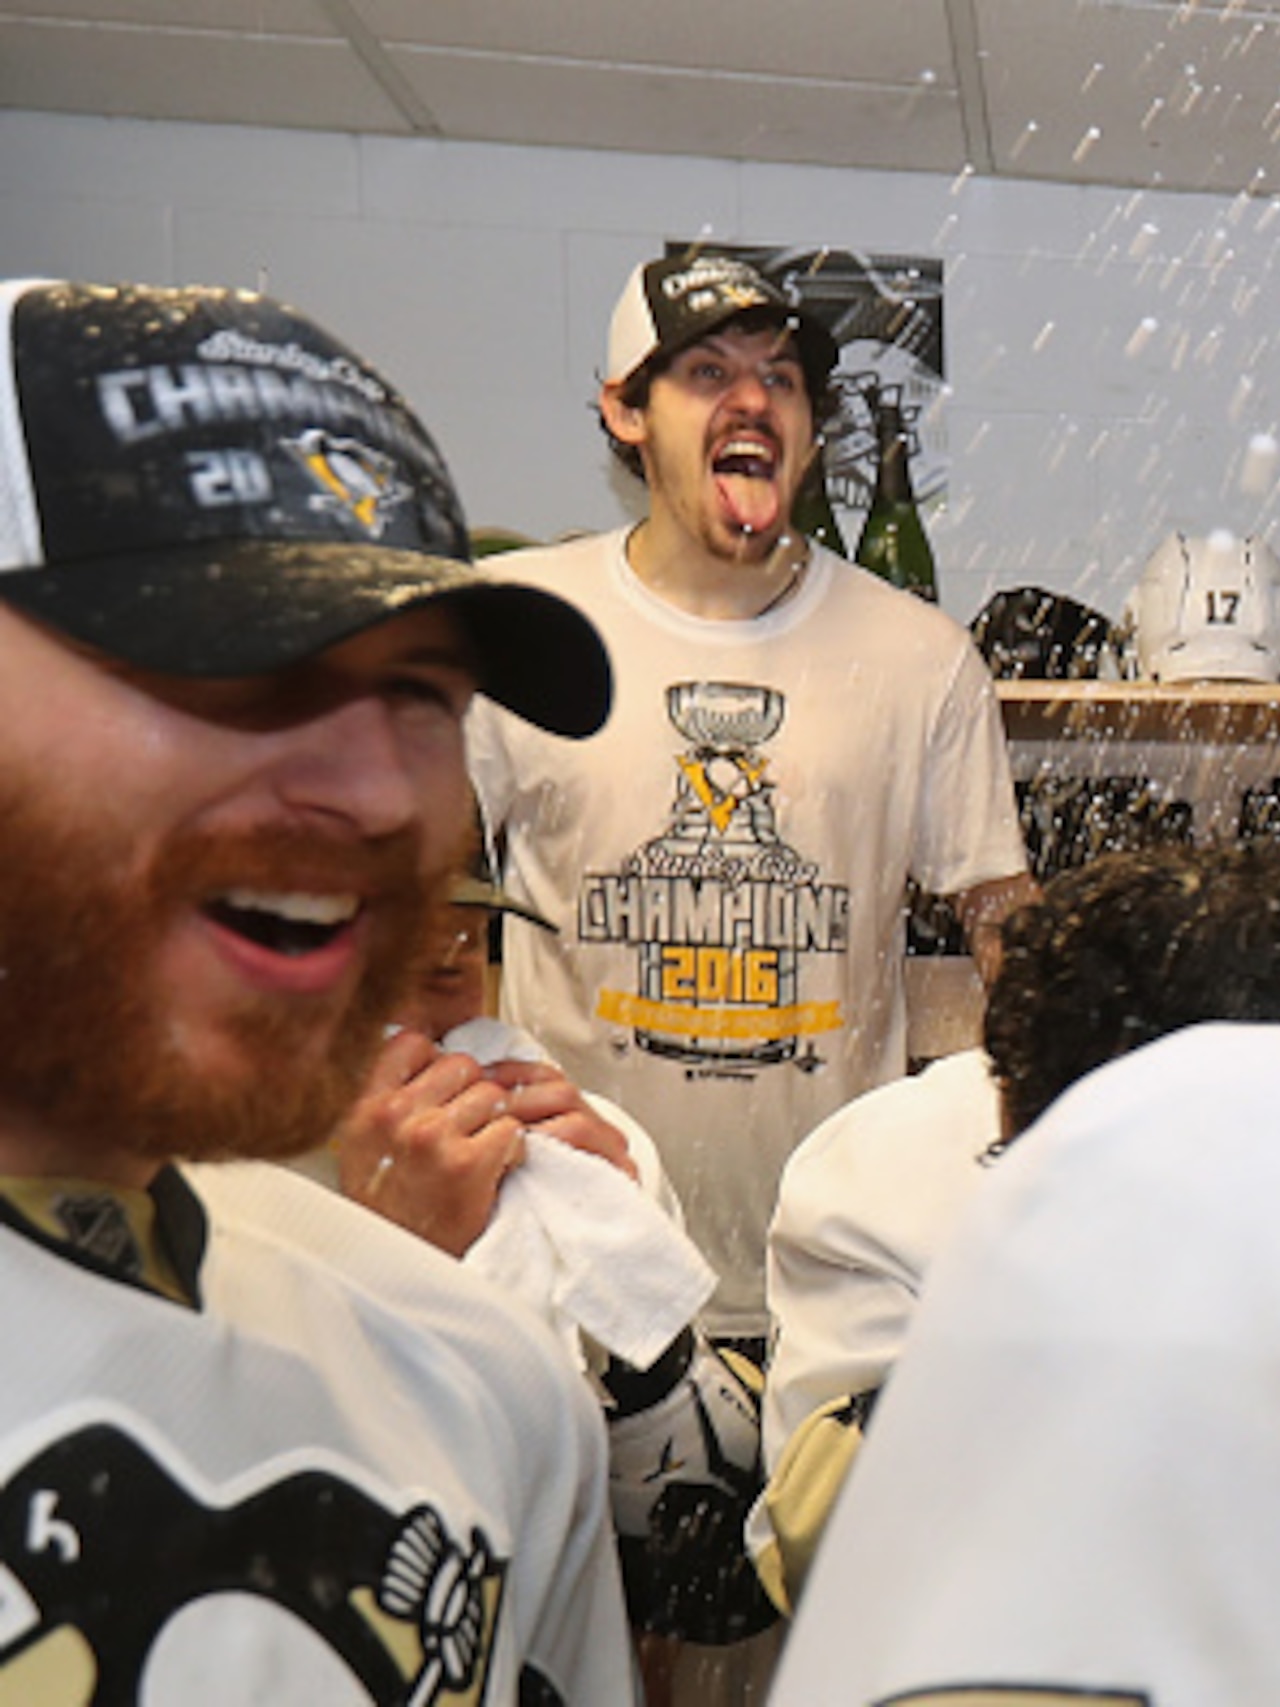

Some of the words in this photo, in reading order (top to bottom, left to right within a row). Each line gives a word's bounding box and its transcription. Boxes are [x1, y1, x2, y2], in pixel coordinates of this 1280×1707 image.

[184, 450, 272, 507] 20
[1206, 590, 1241, 625] 17
[661, 945, 779, 1004] 2016
